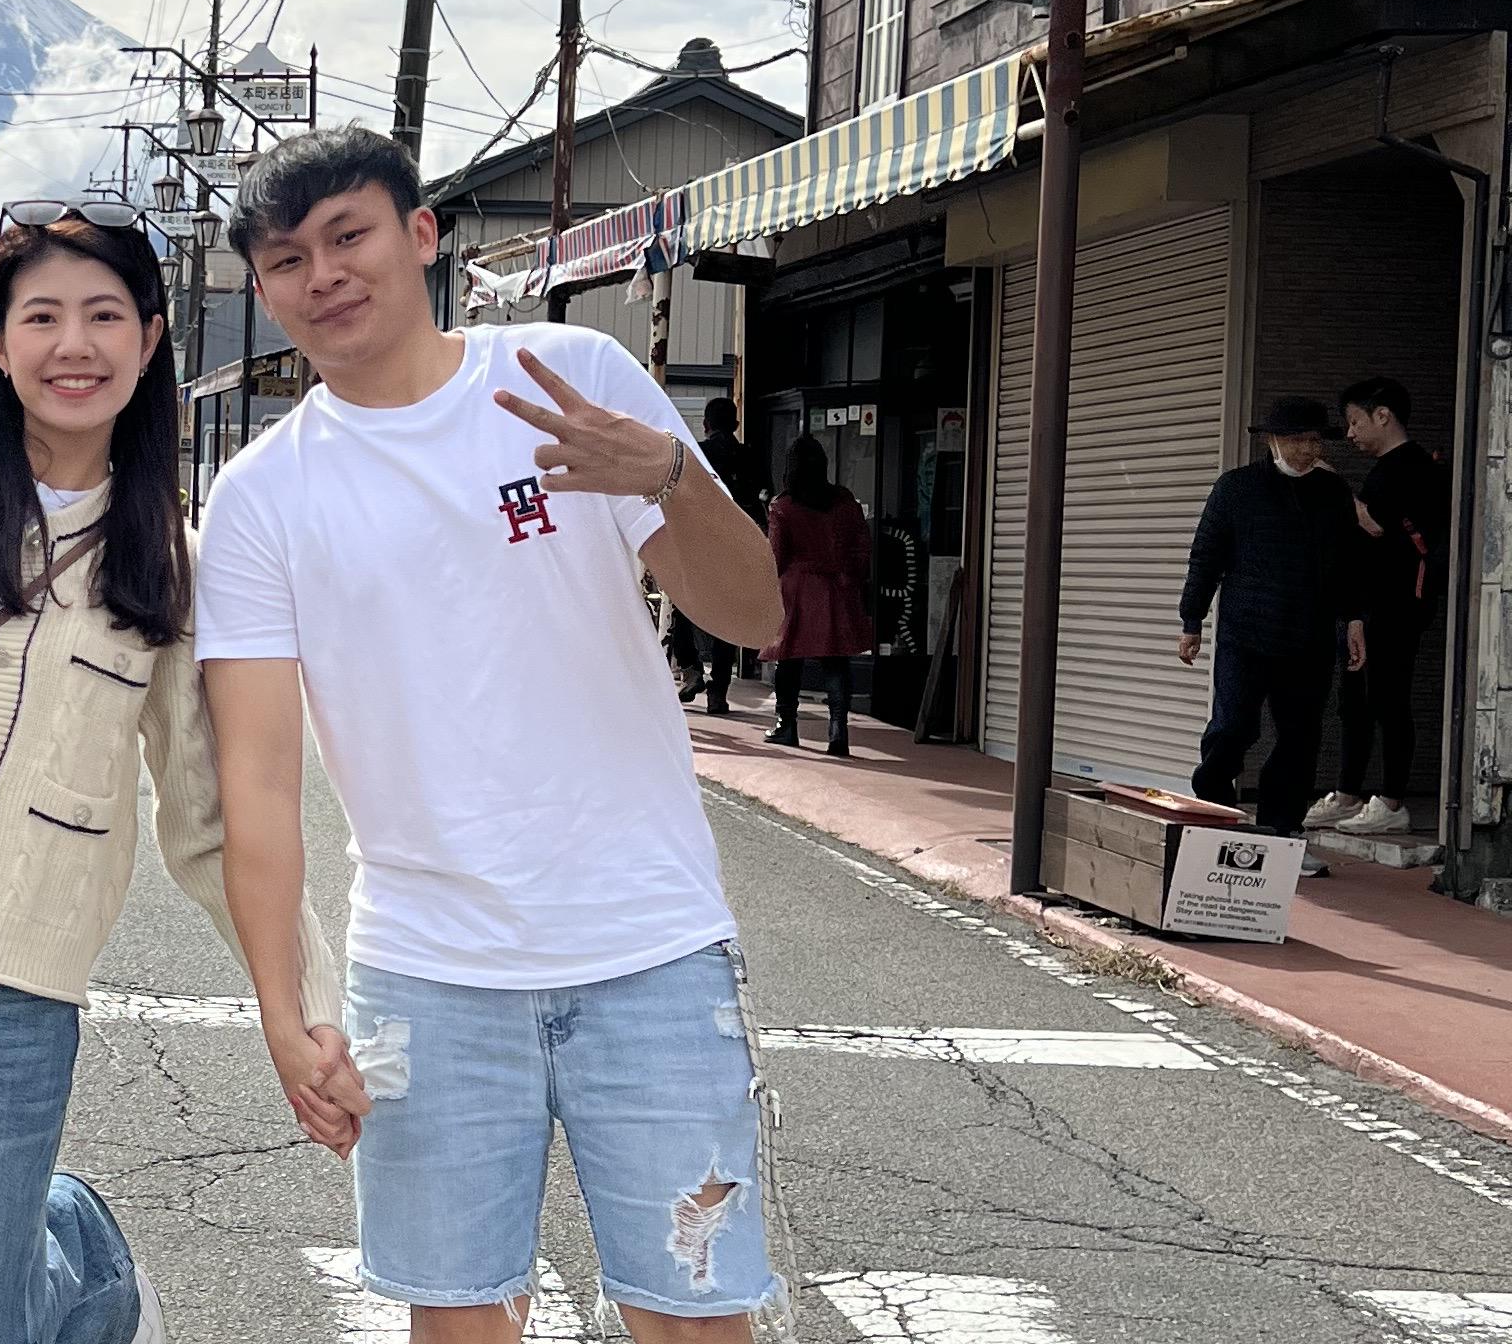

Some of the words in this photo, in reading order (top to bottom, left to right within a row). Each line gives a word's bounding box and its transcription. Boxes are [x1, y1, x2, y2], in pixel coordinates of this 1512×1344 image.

[1207, 871, 1266, 889] CAUTION!
[1180, 890, 1204, 902] Taking
[1176, 906, 1192, 916] Stay
